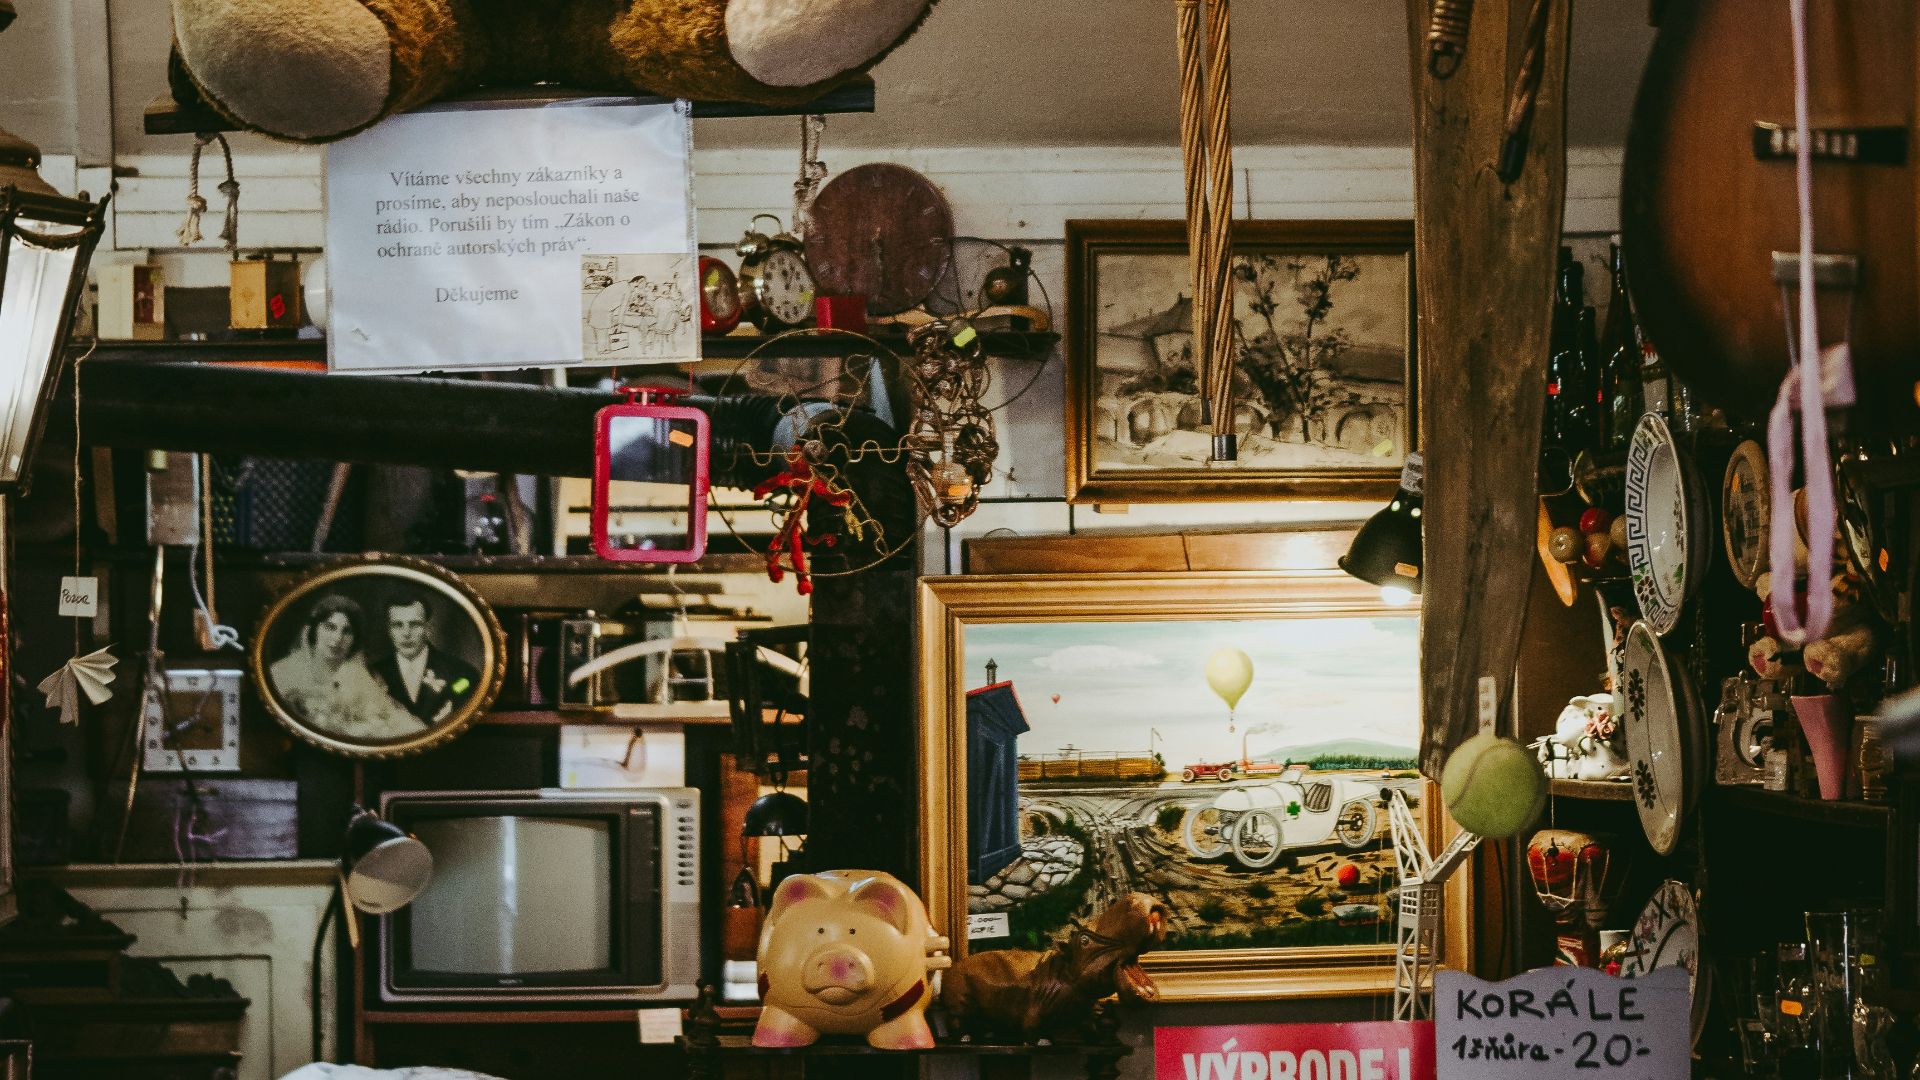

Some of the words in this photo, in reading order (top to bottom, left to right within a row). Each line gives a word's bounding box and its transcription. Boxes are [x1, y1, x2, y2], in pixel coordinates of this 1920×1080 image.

[390, 170, 450, 187] Vítáme
[455, 167, 522, 187] všechny
[527, 165, 609, 184] zákazníky
[613, 168, 623, 179] a
[376, 194, 446, 214] prosíme,
[451, 193, 480, 211] aby
[485, 188, 599, 210] neposlouchali
[604, 189, 641, 203] naše
[376, 217, 423, 234] rádio.
[429, 215, 492, 232] Porušili
[497, 214, 517, 233] by
[522, 213, 549, 229] tím
[620, 214, 631, 226] o
[377, 239, 442, 258] ochraně
[447, 236, 536, 257] autorských
[435, 286, 520, 305] Děkujeme
[1456, 978, 1645, 1021] KORÁLE
